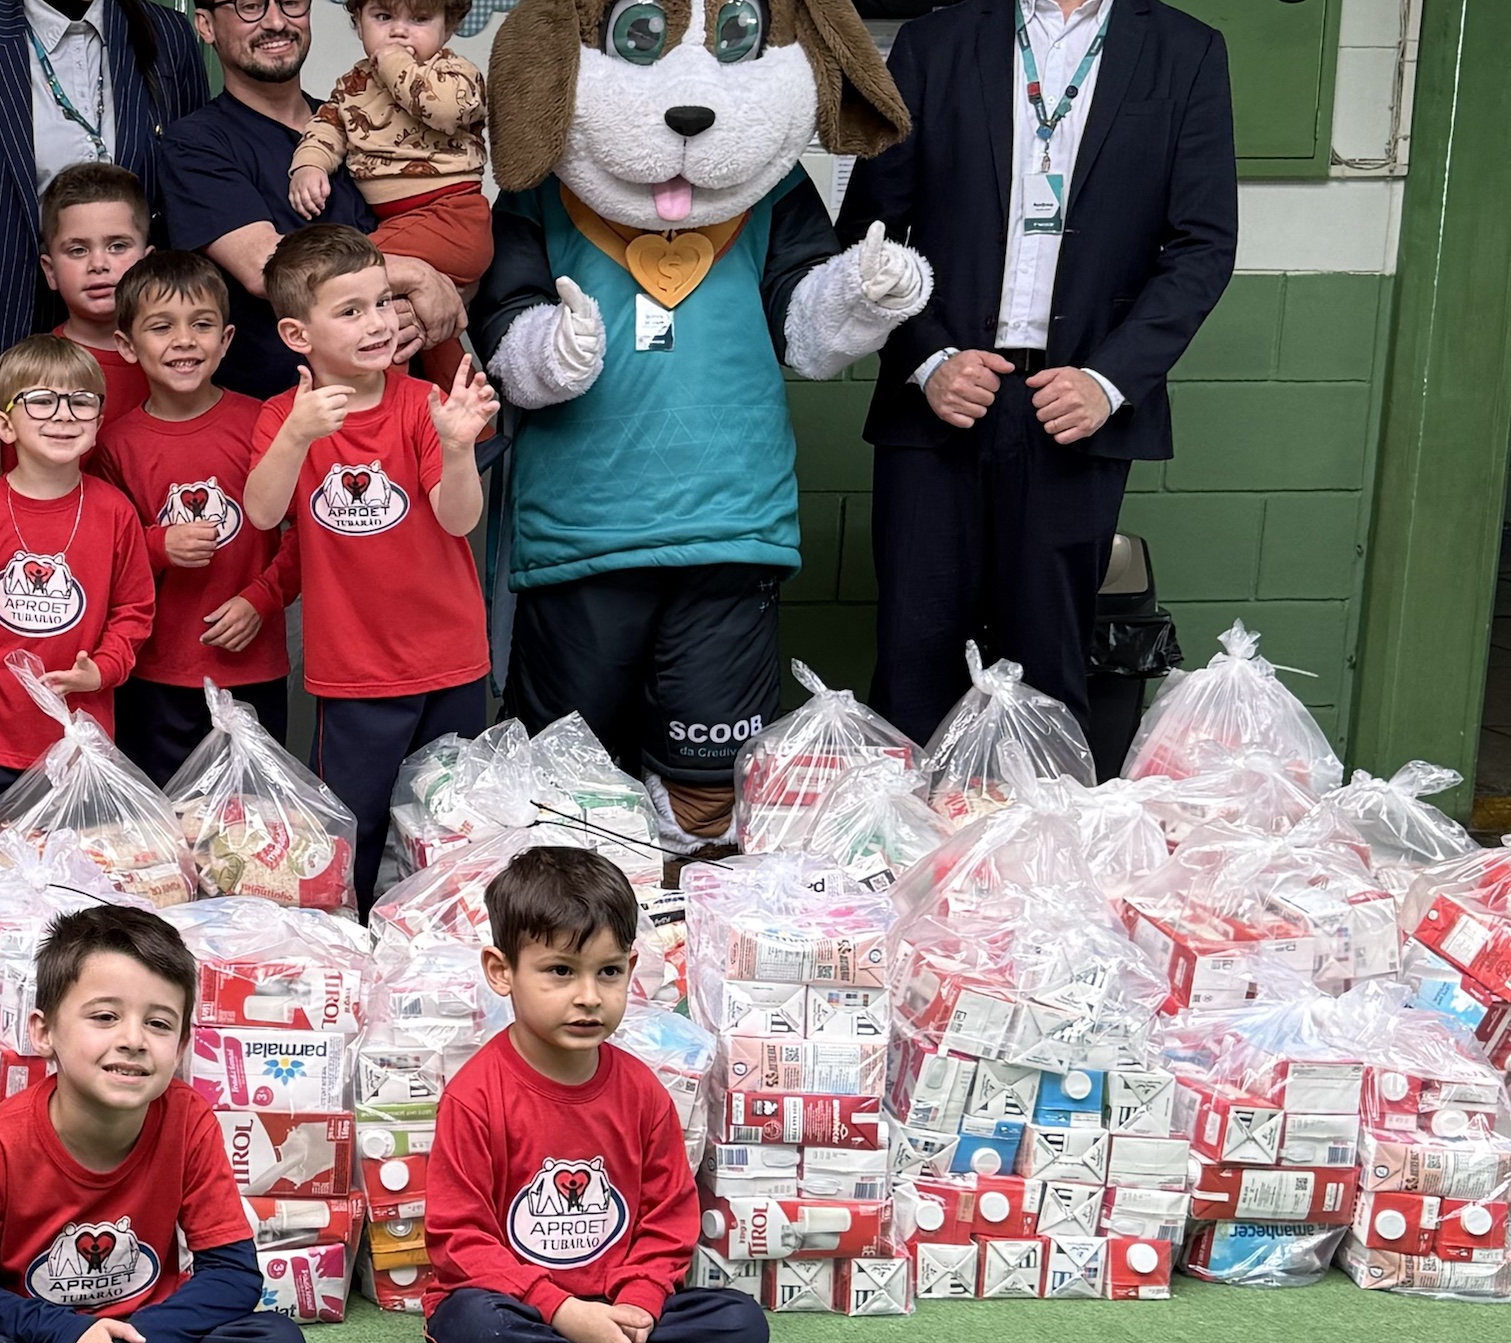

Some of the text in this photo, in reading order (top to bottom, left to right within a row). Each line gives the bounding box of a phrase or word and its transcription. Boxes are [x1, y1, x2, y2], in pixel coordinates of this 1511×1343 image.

[327, 506, 390, 518] APROET
[4, 597, 71, 614] APROET
[668, 714, 763, 744] SCOOB
[322, 969, 344, 1030] TIROL
[245, 1041, 327, 1058] parmalat
[530, 1219, 608, 1236] APROET
[748, 1201, 770, 1258] TIROL
[1230, 1223, 1315, 1240] amanhecer
[540, 1235, 600, 1251] TUBARÃO
[49, 1273, 135, 1292] APROET
[60, 1287, 123, 1303] TUBARÃO
